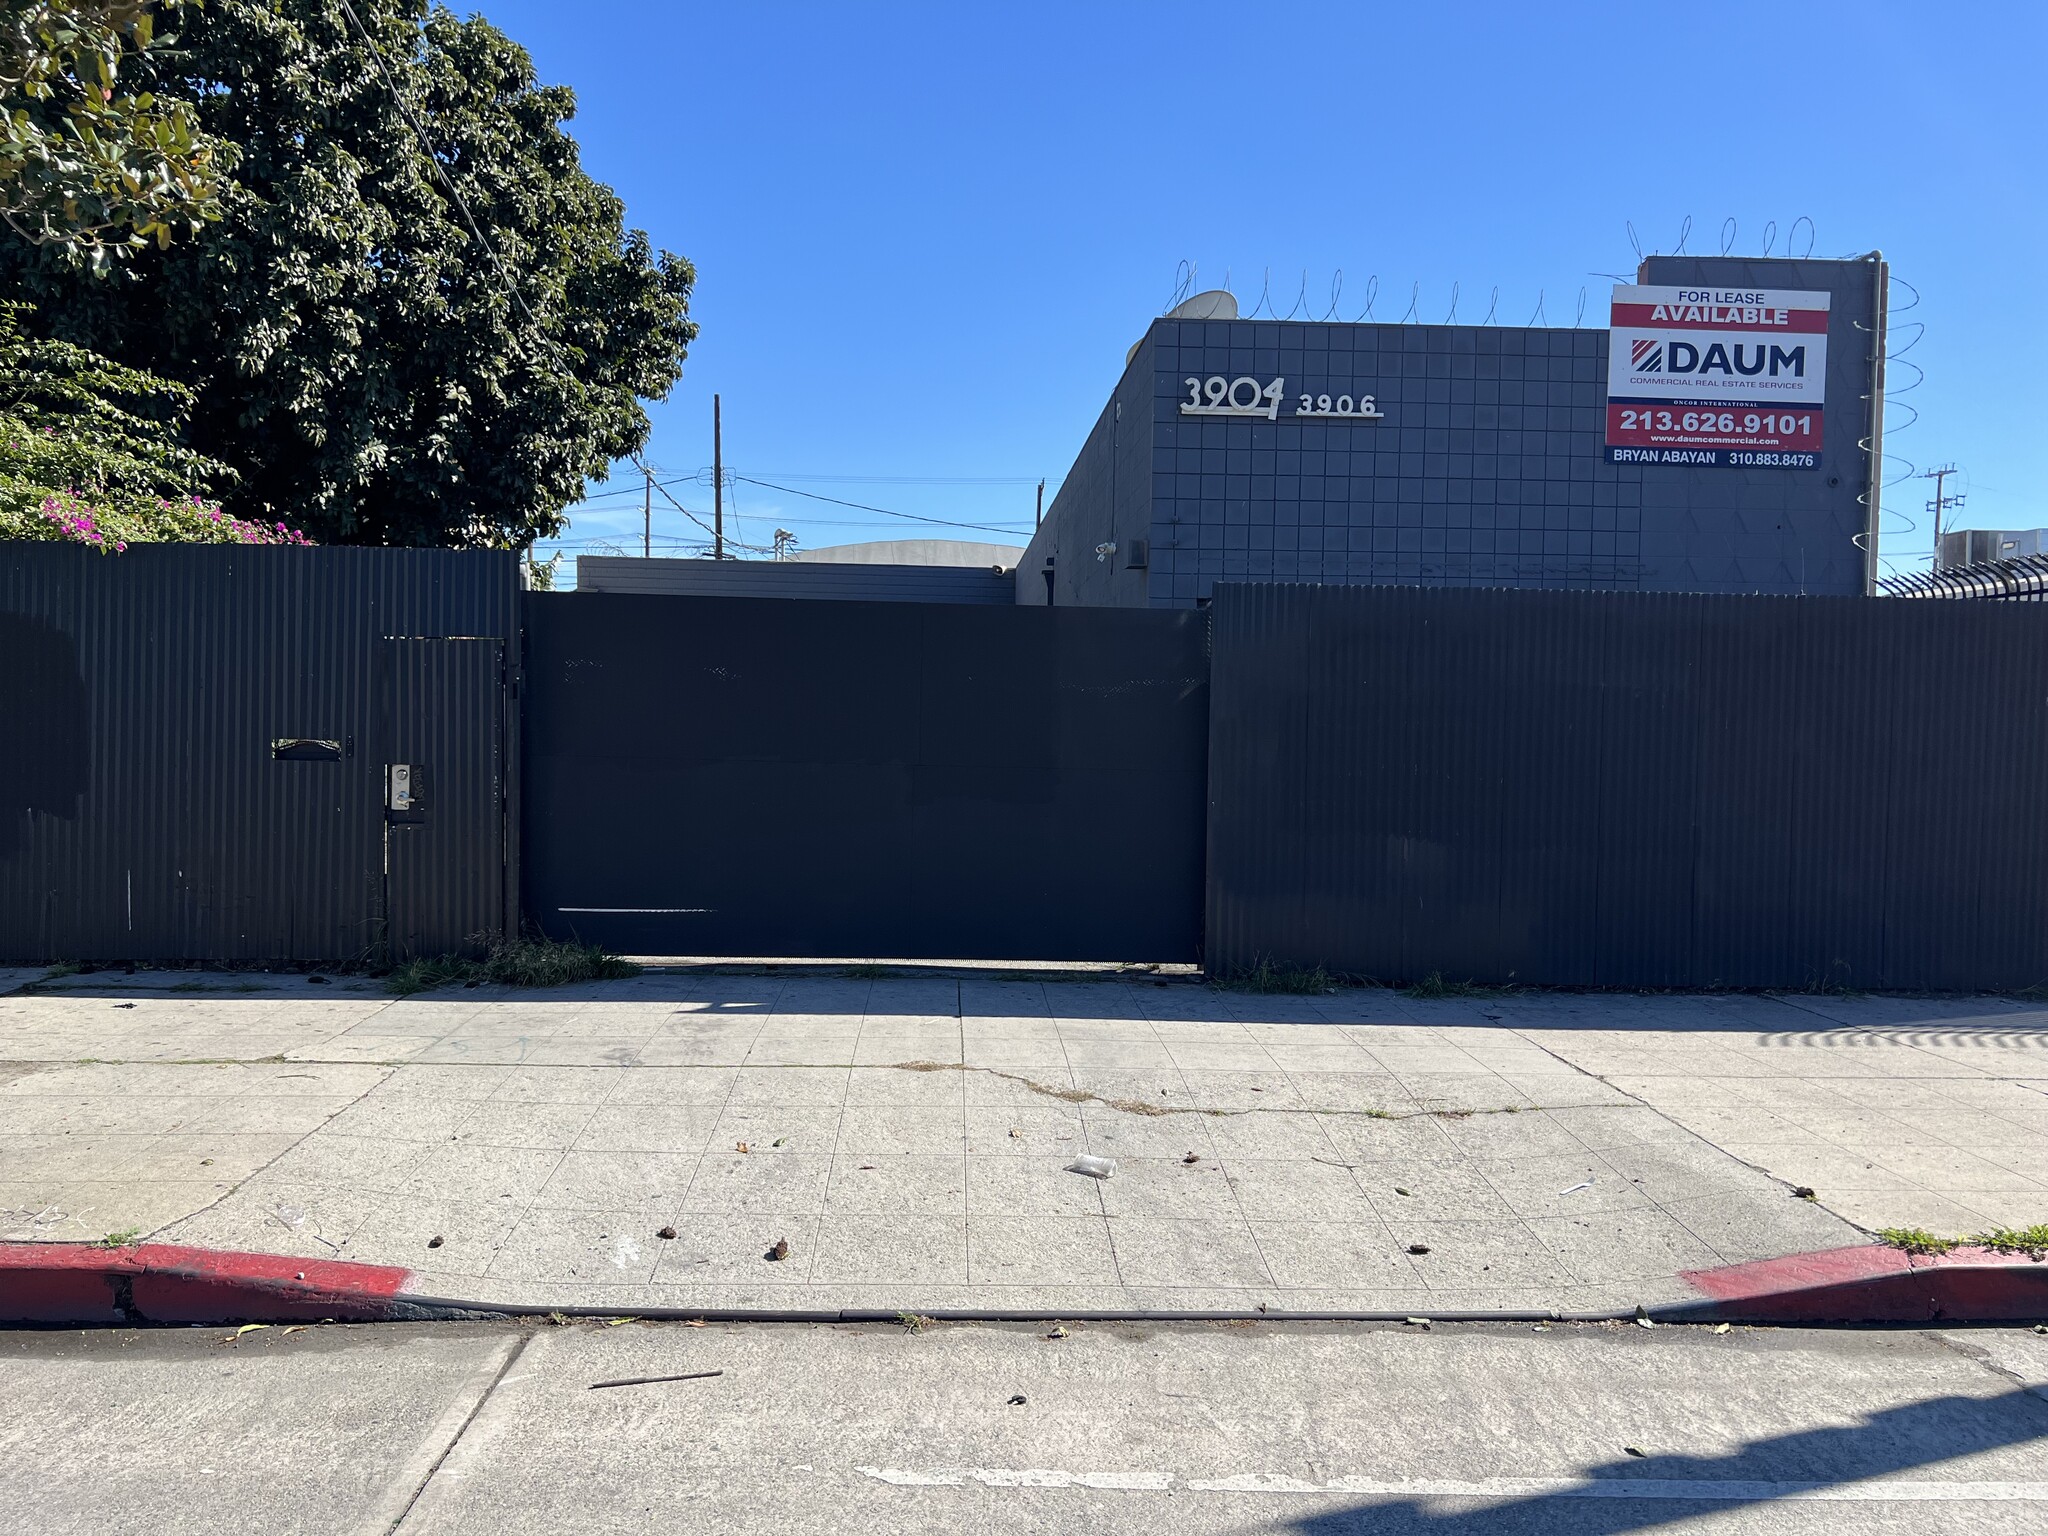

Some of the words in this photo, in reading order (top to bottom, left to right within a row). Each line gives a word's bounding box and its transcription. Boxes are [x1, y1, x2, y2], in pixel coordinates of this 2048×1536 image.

[1679, 291, 1711, 303] FOR
[1716, 293, 1765, 304] LEASE
[1651, 305, 1788, 325] AVAILABLE
[1668, 342, 1805, 377] DAUM
[1630, 377, 1693, 386] COMMERCIAL
[1180, 376, 1284, 421] 3904
[1296, 393, 1376, 416] 3906
[1620, 411, 1811, 435] 213.626.9101
[1650, 434, 1780, 445] www.daumcommercial.com
[1614, 449, 1658, 462] BRYAN
[1662, 451, 1715, 463] ABAYAN
[1730, 453, 1813, 466] 310.883.8476
